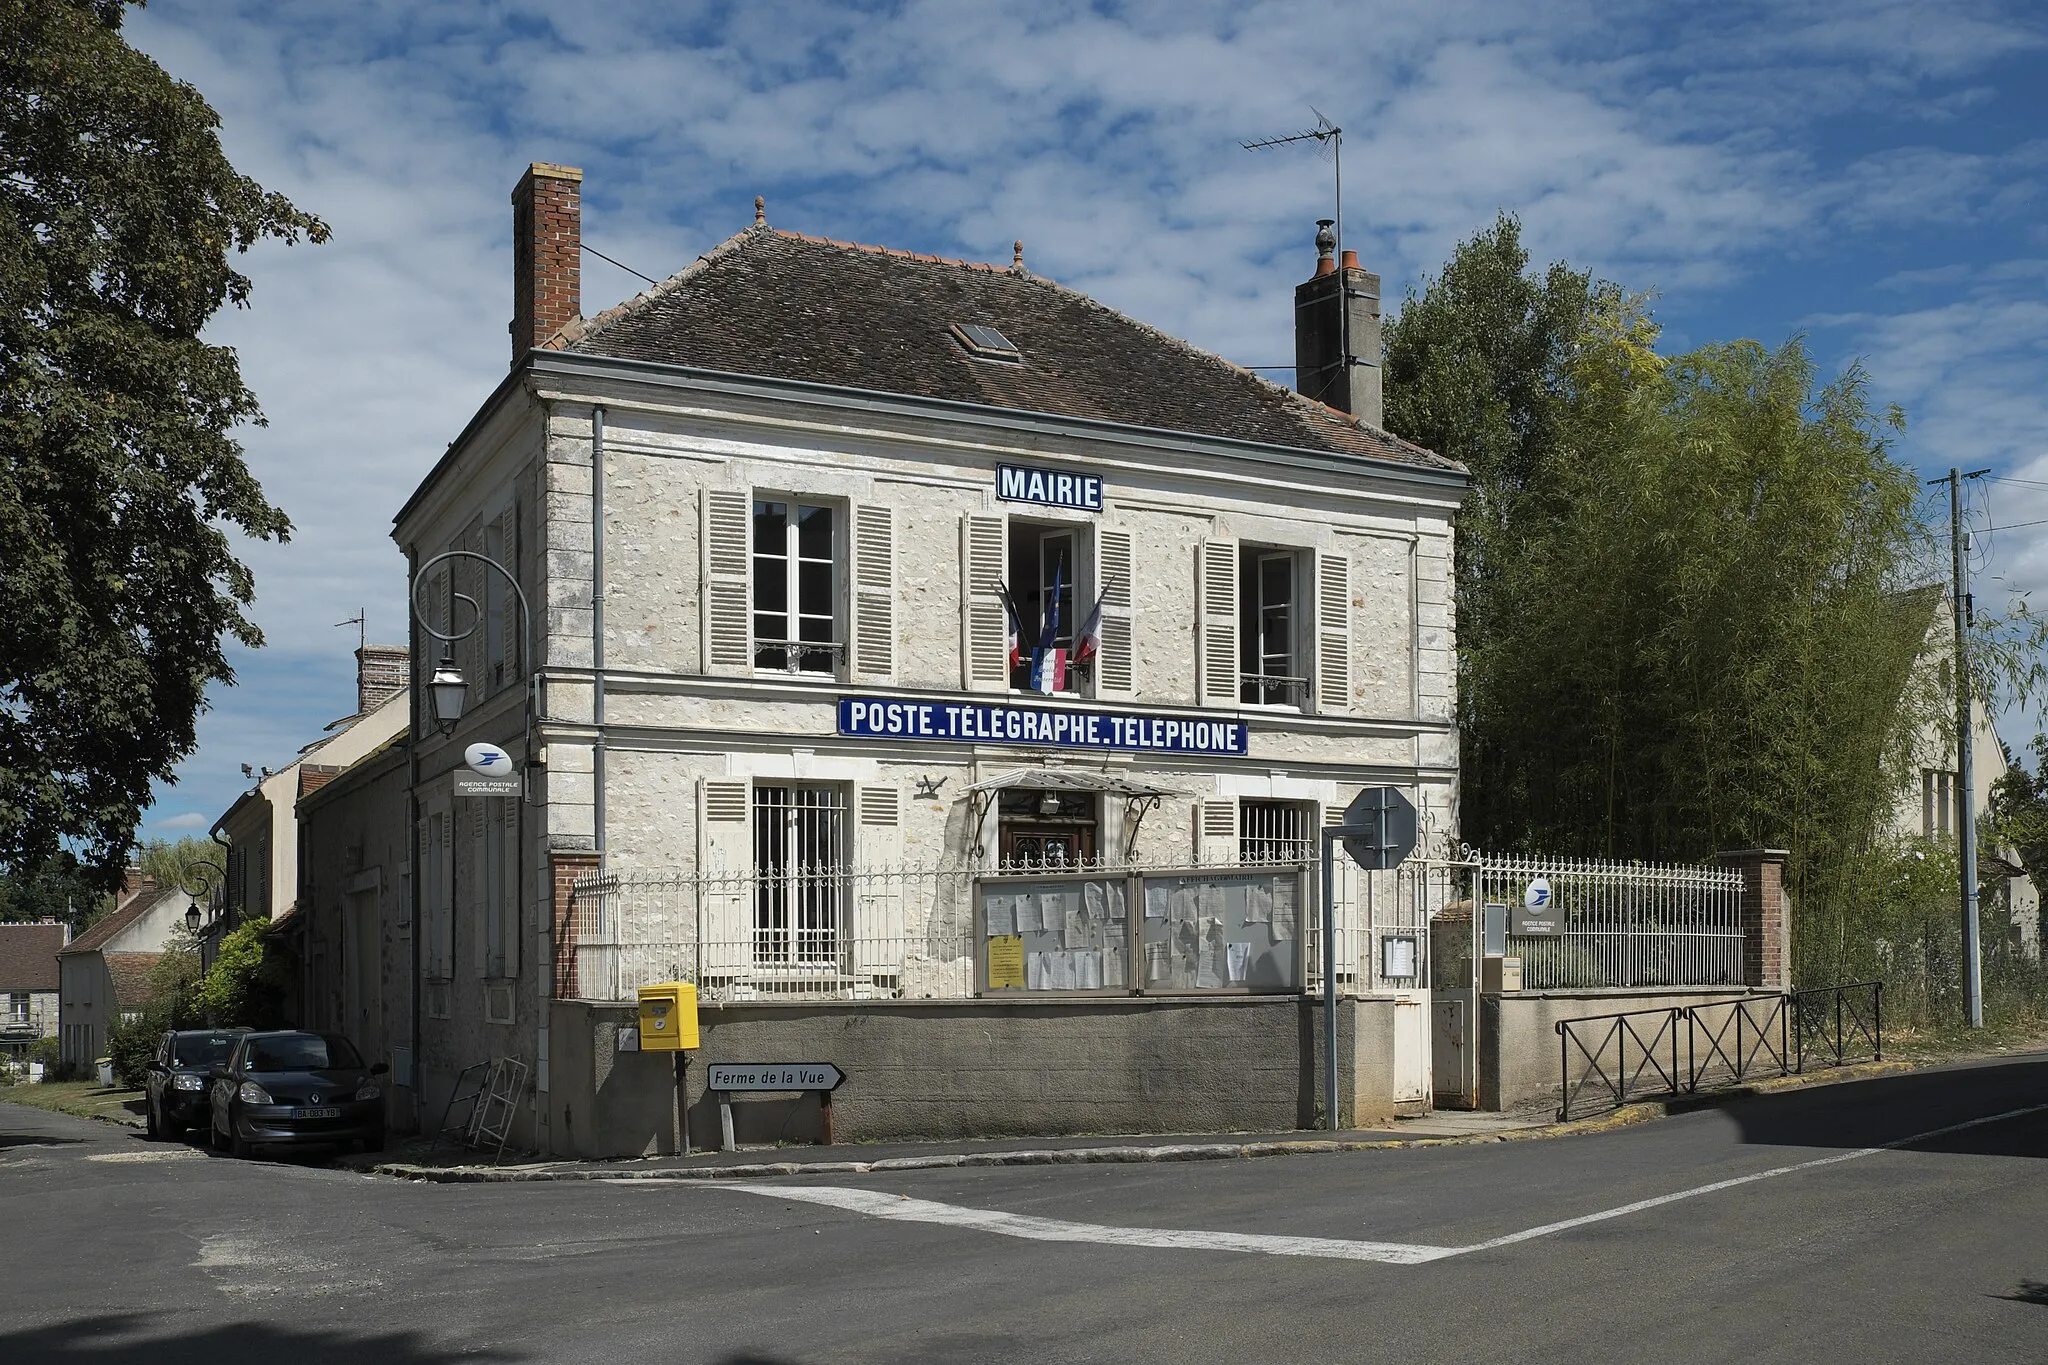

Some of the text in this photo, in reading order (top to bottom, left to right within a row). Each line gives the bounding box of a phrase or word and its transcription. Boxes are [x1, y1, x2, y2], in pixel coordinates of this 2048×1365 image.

[1002, 467, 1099, 507] MAIRIE
[714, 1070, 825, 1084] Ferme de la Vue
